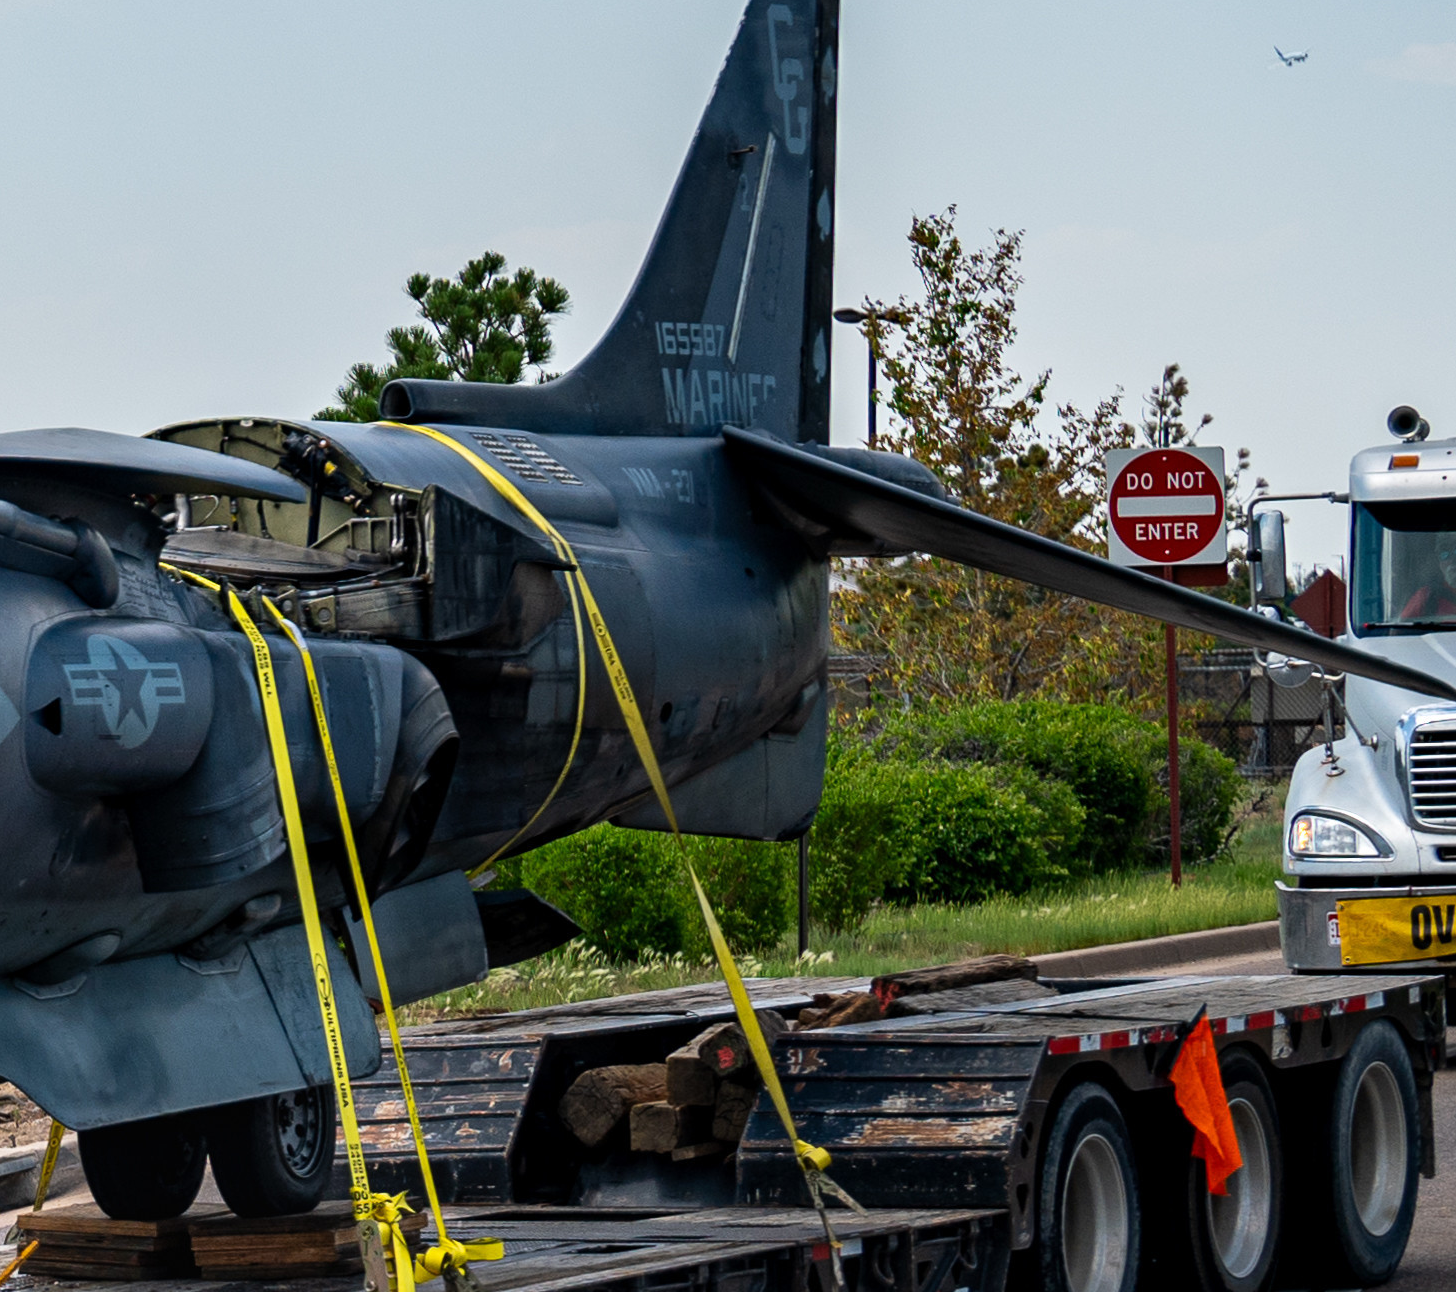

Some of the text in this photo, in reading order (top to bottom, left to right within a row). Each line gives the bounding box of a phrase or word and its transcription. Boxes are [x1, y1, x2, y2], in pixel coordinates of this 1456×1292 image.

[1126, 471, 1205, 490] DO NOT
[1135, 522, 1199, 541] ENTER
[1411, 904, 1456, 950] OV
[339, 1082, 350, 1108] USA
